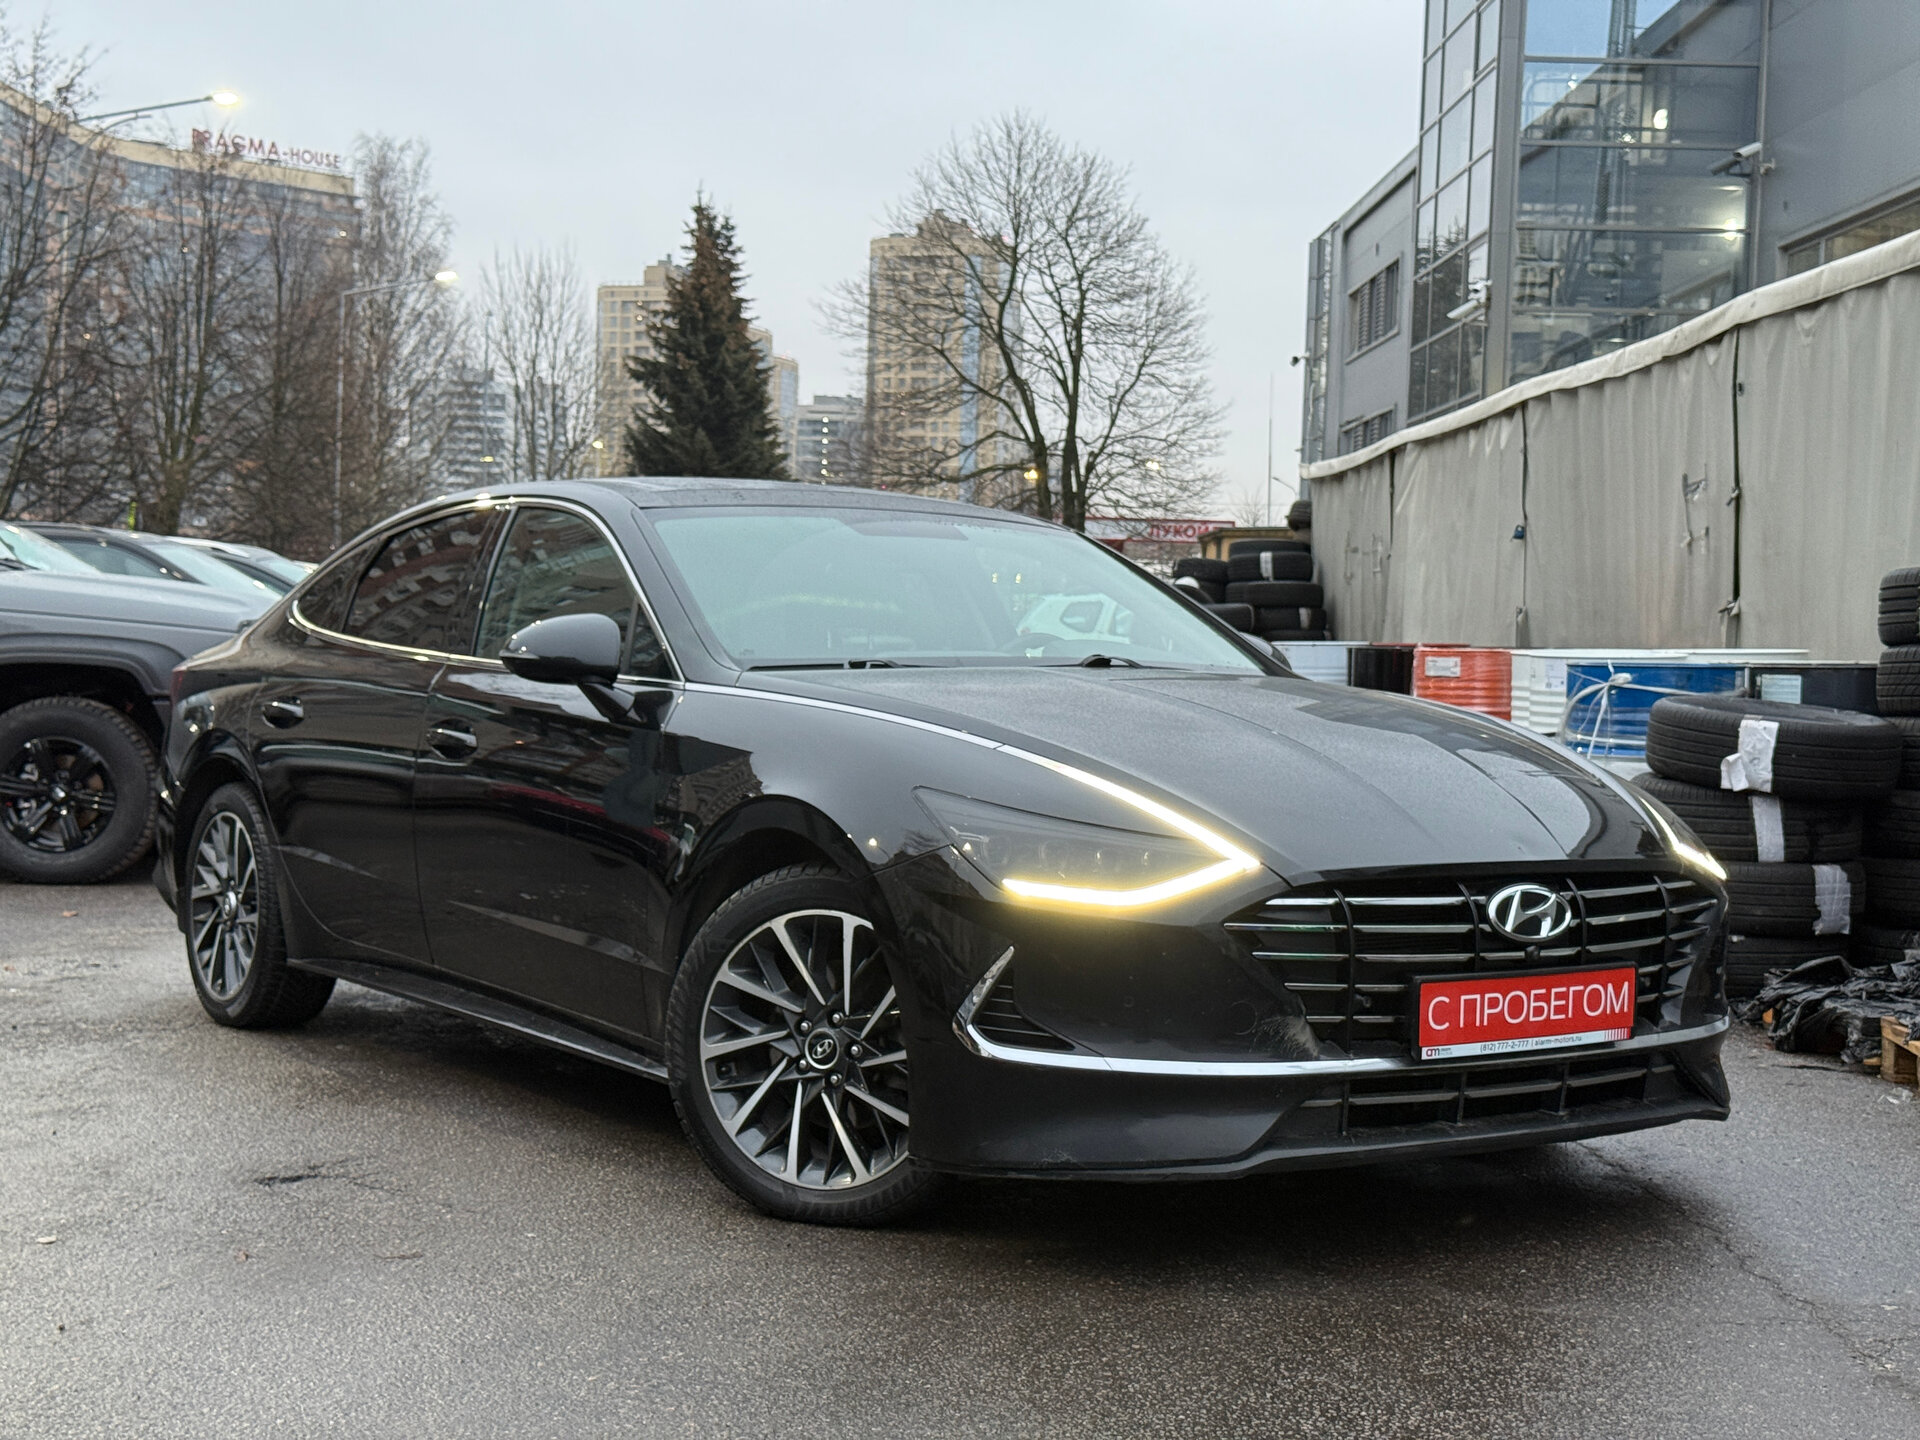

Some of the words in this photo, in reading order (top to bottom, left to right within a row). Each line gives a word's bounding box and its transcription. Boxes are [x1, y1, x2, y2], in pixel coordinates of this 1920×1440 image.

[1148, 521, 1221, 539] ЛУКОЙ
[1428, 996, 1450, 1031] С
[1459, 981, 1630, 1028] ПРОБЕГОМ
